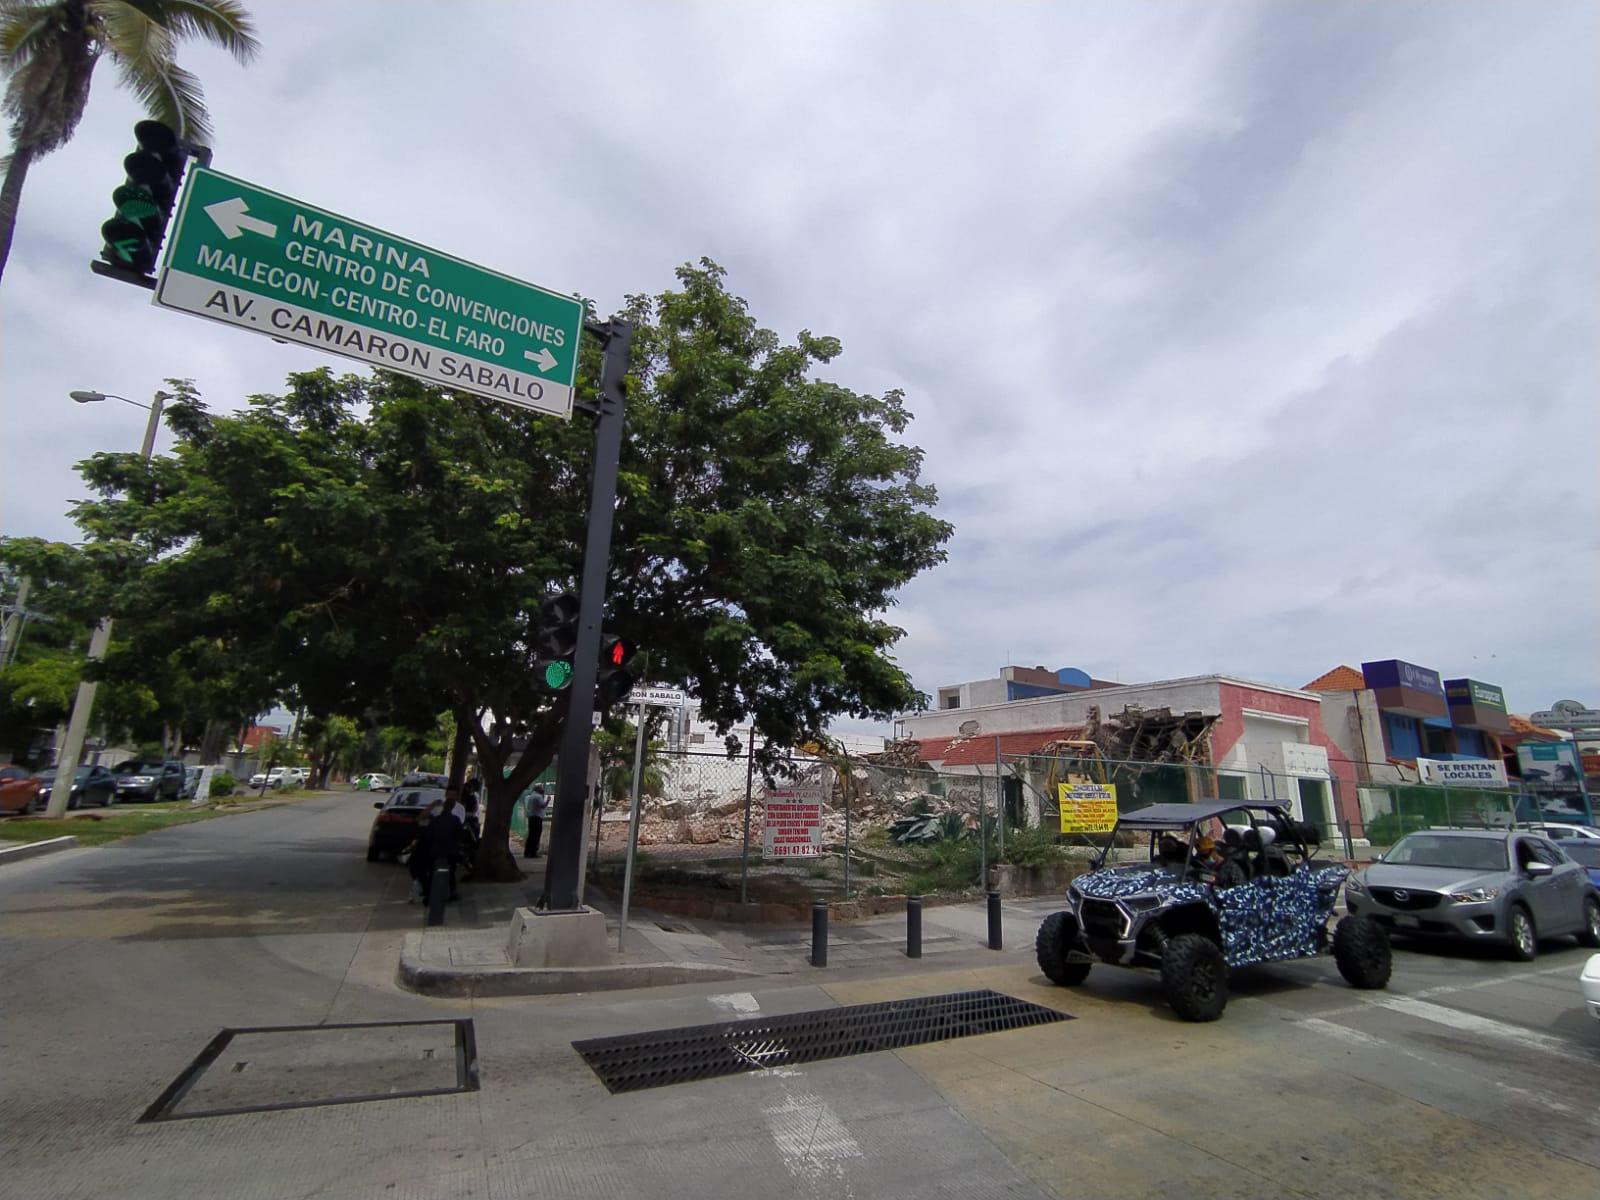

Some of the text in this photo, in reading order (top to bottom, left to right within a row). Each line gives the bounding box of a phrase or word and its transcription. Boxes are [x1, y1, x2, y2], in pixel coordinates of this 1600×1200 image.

[292, 214, 430, 278] MARINA
[285, 241, 565, 347] CENTRO DE CONVENCIONES
[205, 290, 544, 401] AV. CAMARON SABALO
[455, 325, 505, 356] FARO
[649, 692, 681, 700] SABALO
[1453, 763, 1497, 771] RENTAN
